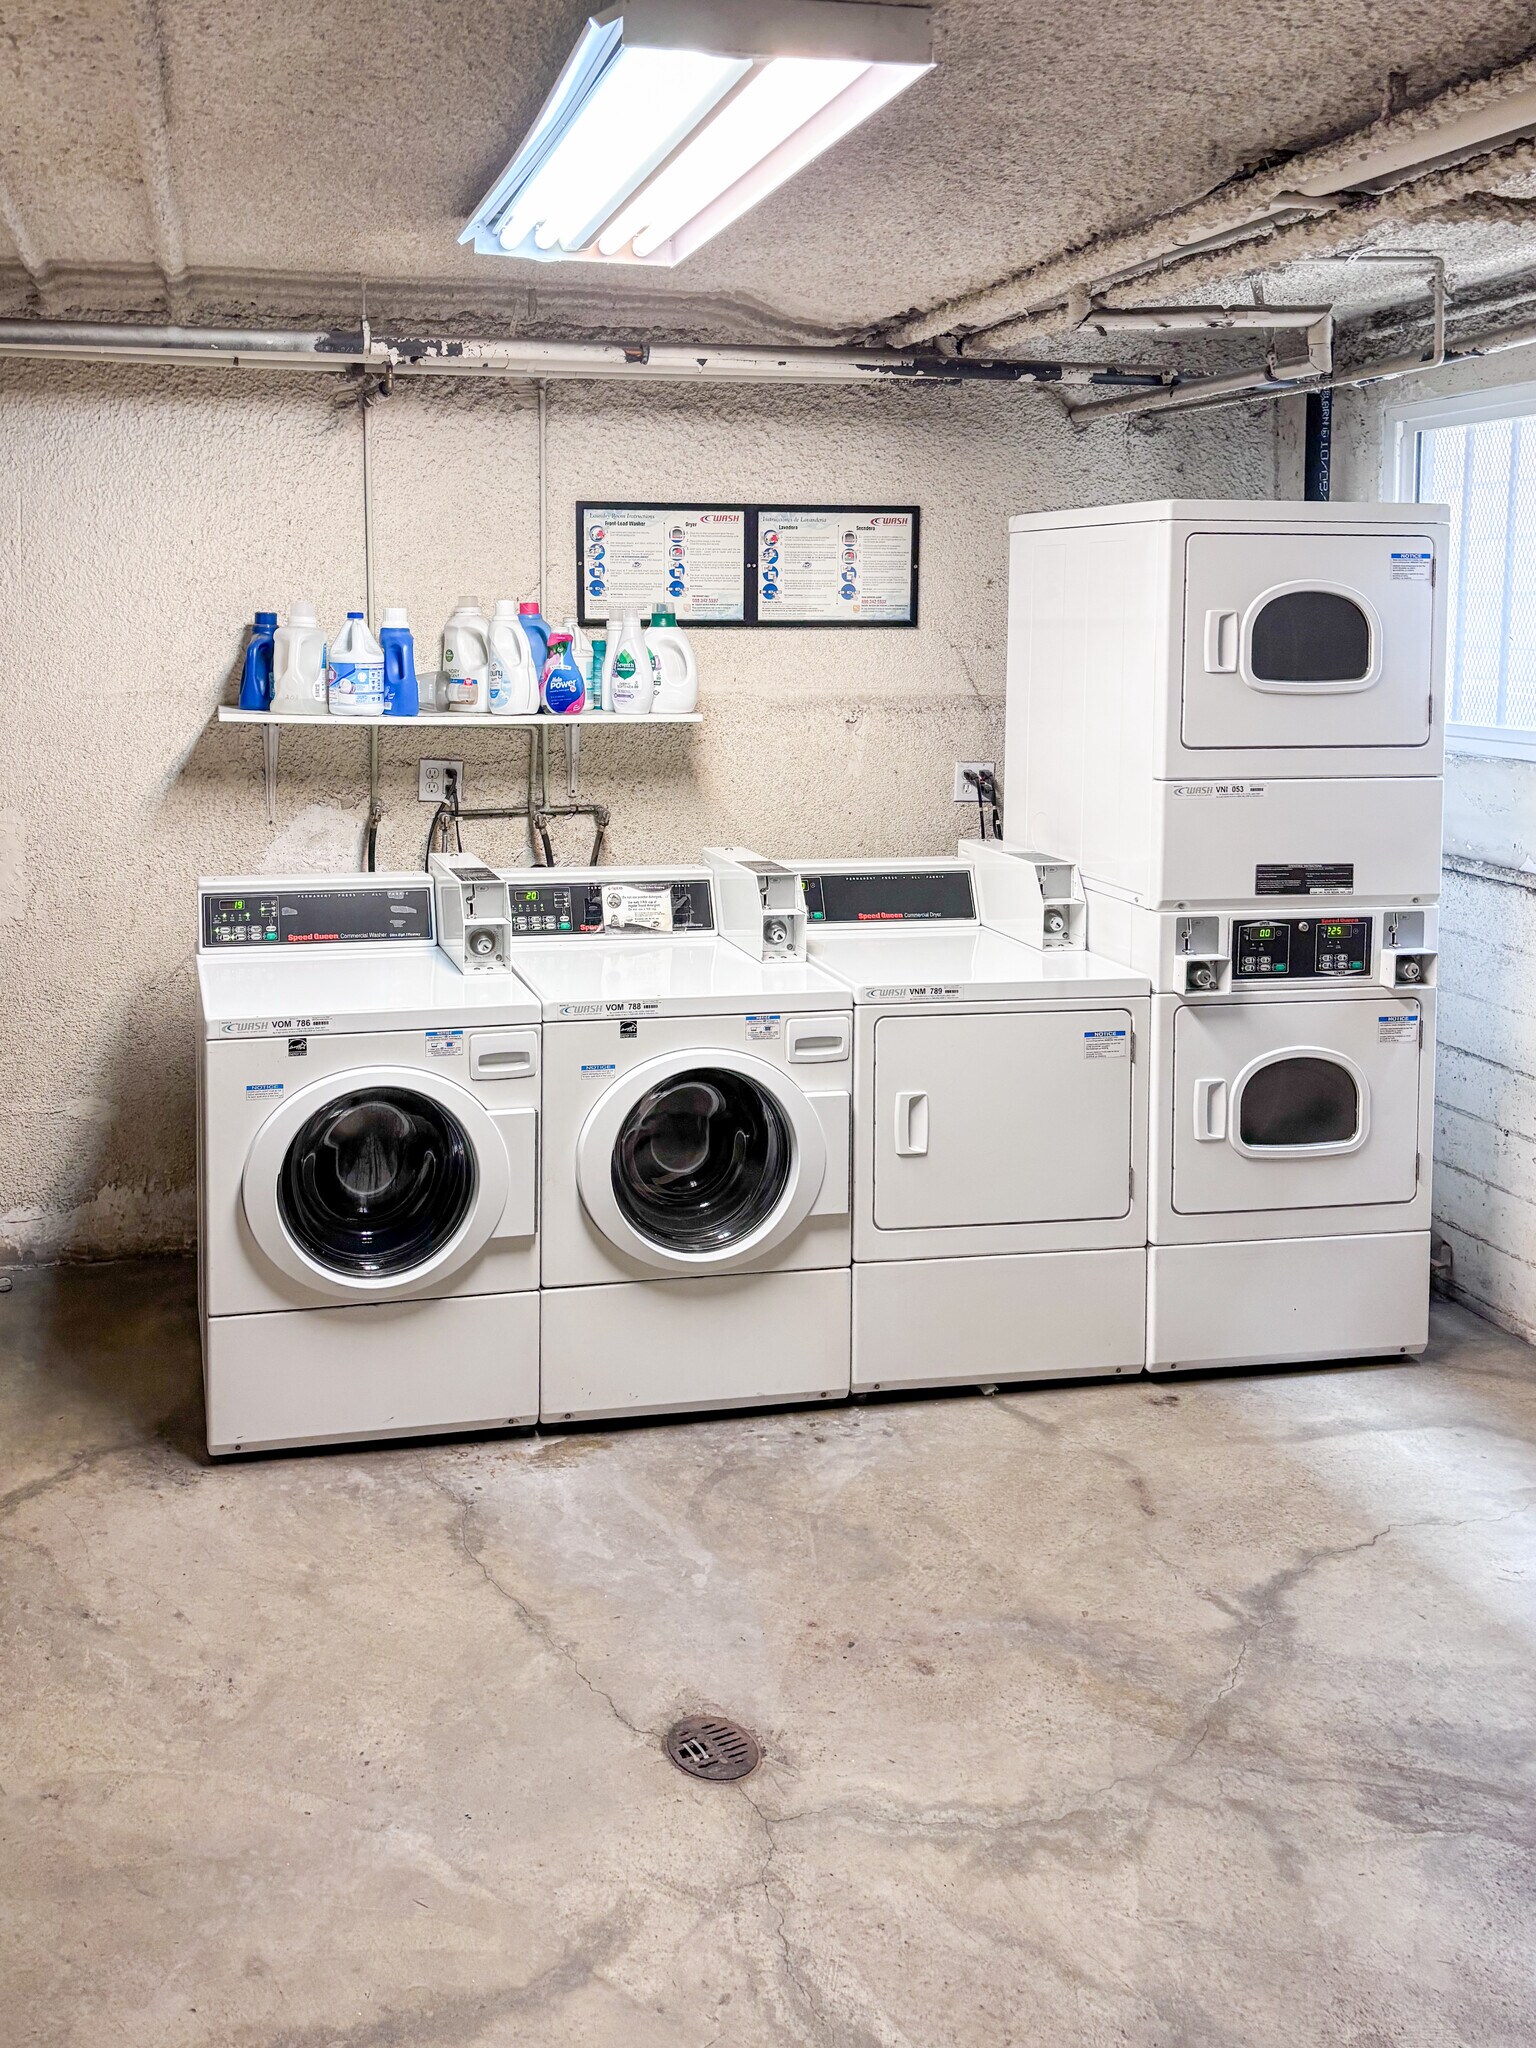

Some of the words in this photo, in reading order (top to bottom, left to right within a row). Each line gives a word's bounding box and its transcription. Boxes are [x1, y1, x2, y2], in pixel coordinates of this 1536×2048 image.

[1186, 786, 1213, 794] WASH
[526, 892, 537, 900] 20
[234, 901, 243, 909] 19
[858, 912, 880, 920] Speed
[288, 934, 313, 942] Speed
[574, 1005, 603, 1013] WASH
[237, 1022, 268, 1031] WASH
[296, 1019, 311, 1027] 786
